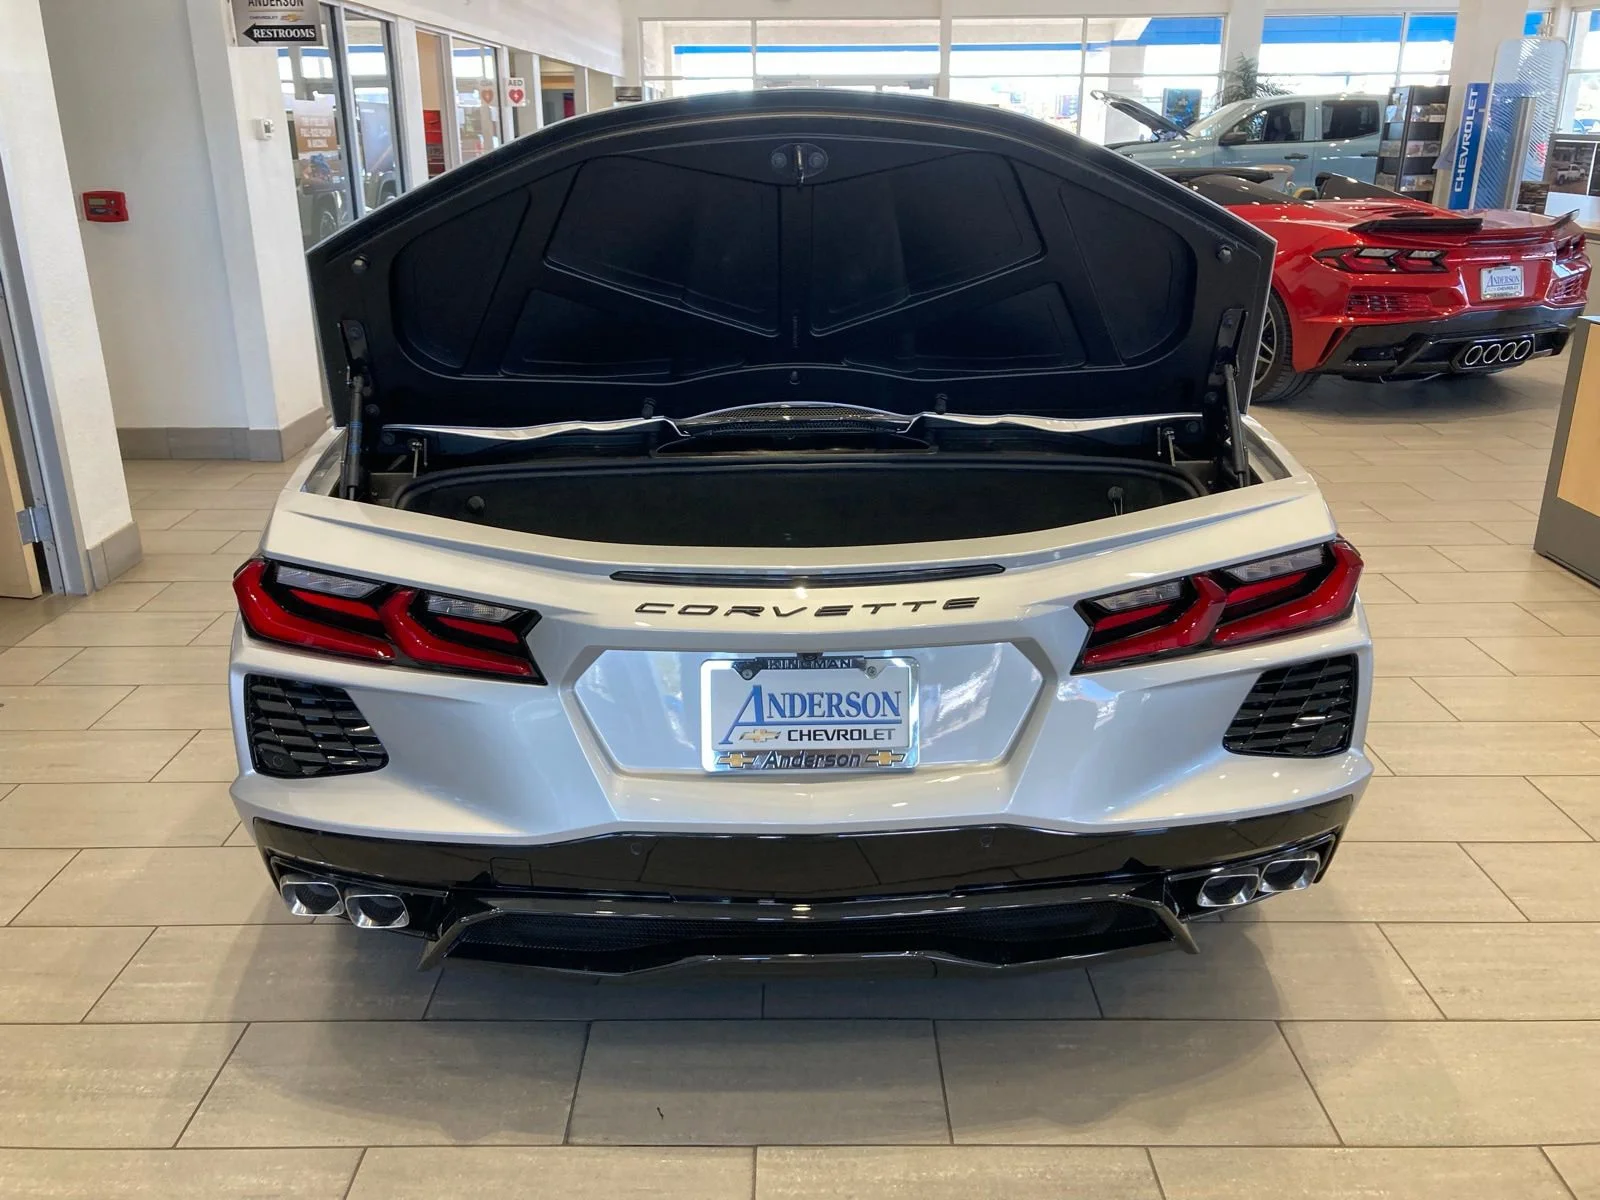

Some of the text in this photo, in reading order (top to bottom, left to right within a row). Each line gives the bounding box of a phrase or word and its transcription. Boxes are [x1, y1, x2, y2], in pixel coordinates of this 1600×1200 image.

[253, 28, 315, 38] RESTROOMS
[1454, 88, 1478, 192] CHEVROLET
[635, 597, 980, 617] CORVETTE
[768, 659, 853, 669] KINGMAN
[718, 685, 902, 744] ANDERSON
[788, 728, 896, 742] CHEVROLET
[761, 750, 861, 768] Anderson
